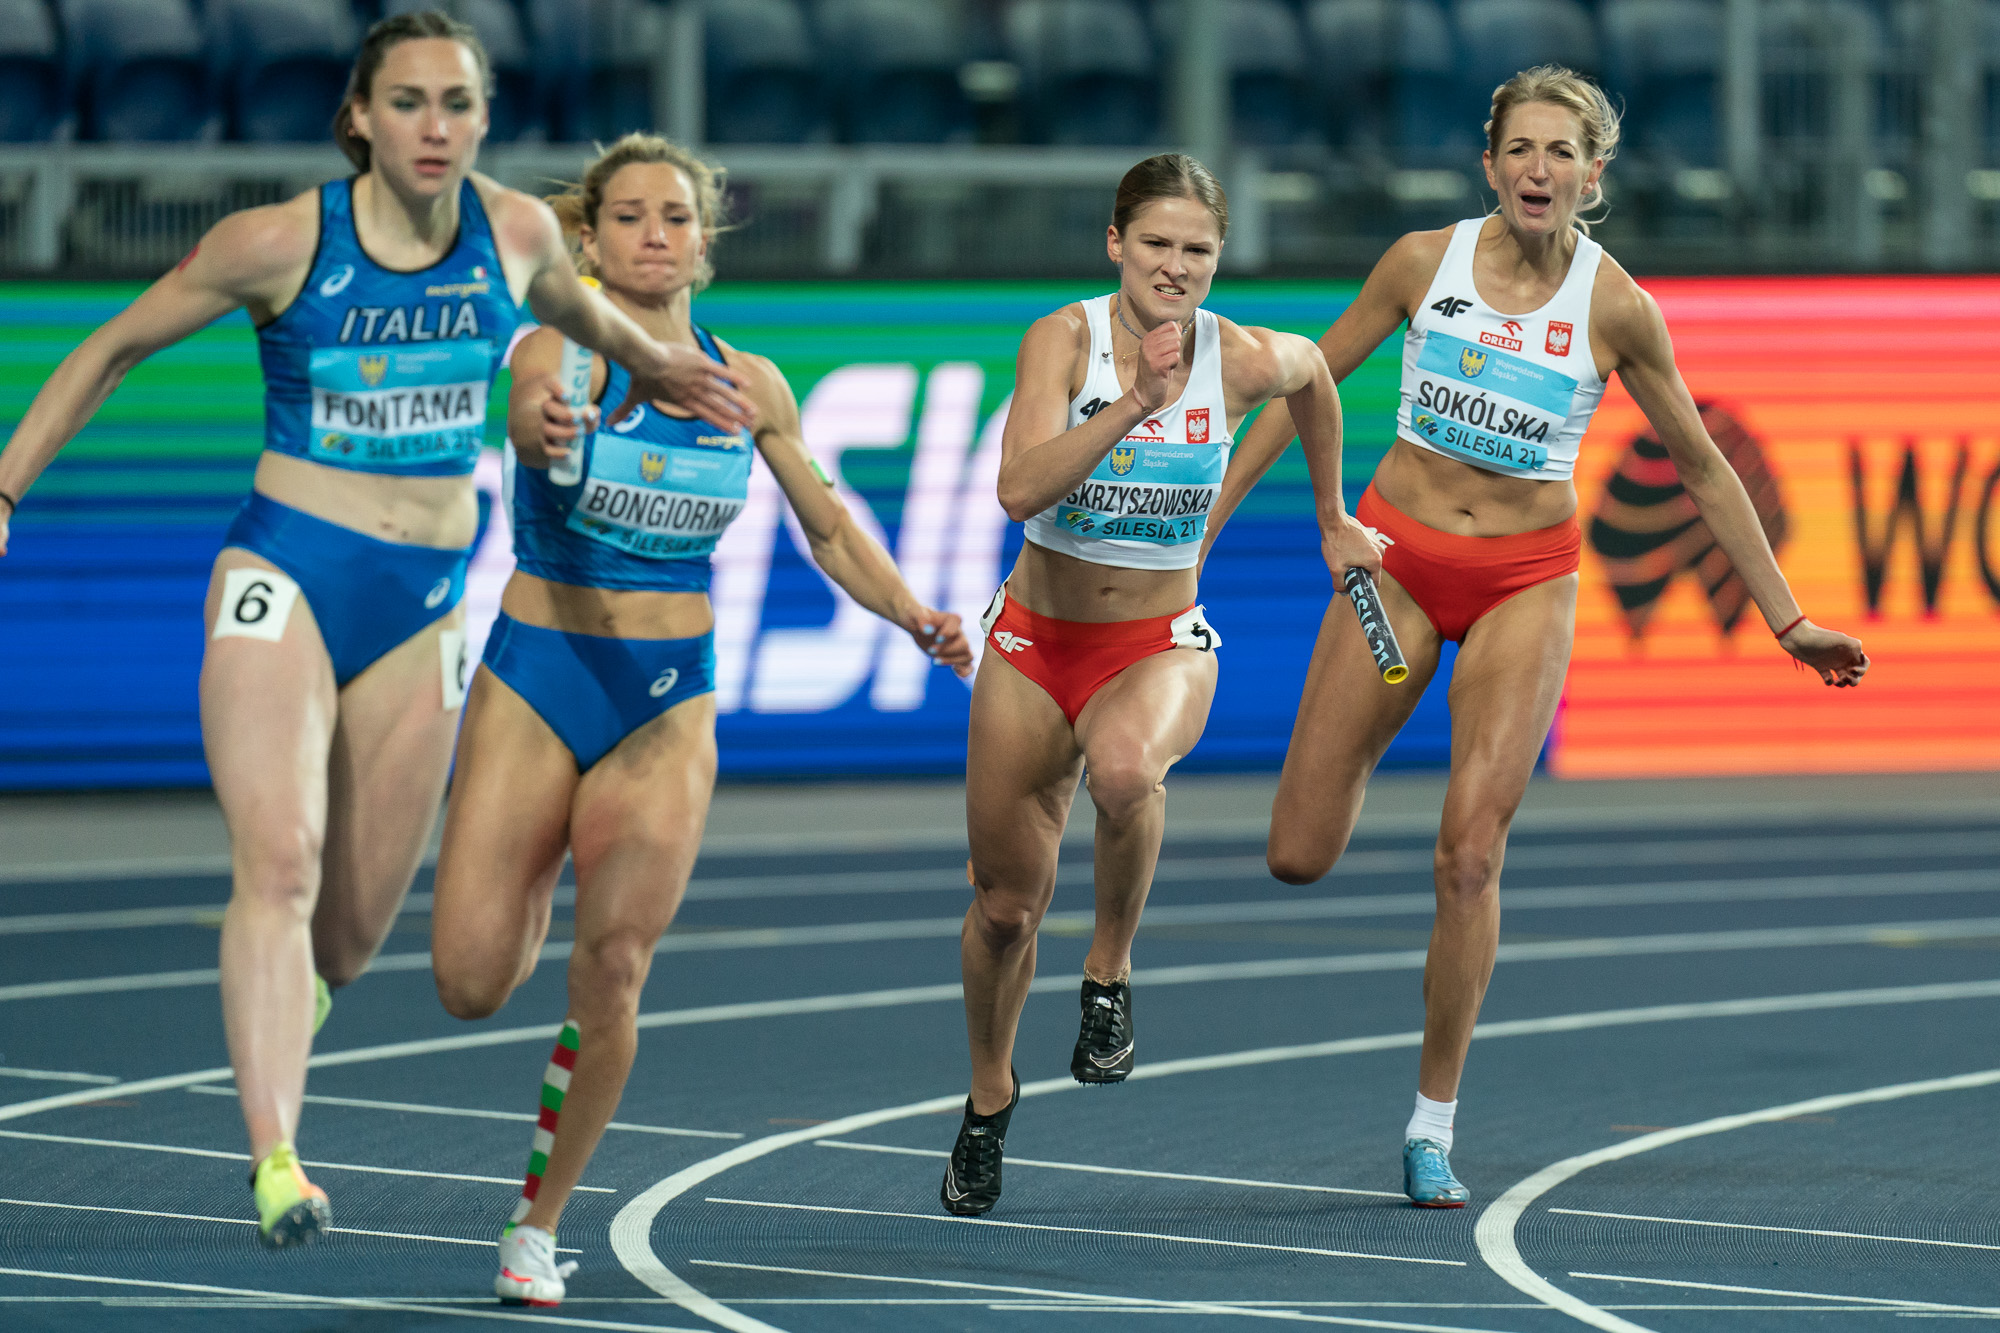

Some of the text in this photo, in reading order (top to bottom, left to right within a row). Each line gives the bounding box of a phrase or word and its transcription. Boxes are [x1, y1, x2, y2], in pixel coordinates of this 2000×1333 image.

[1431, 296, 1474, 318] 4F
[339, 301, 479, 343] ITALIA
[1549, 321, 1572, 330] POLSKA
[1481, 333, 1522, 351] ORLEN
[1495, 358, 1545, 381] Województwo
[324, 387, 474, 431] FONTANA
[1417, 380, 1550, 444] SOKÓLSKA
[366, 436, 448, 460] SILESIA
[1144, 449, 1194, 459] Województwo
[1444, 426, 1537, 466] SILESIA 21
[588, 485, 738, 531] BONGIORN
[1066, 482, 1213, 517] SKRZYSZOWSKA
[1102, 519, 1197, 540] SILESIA 21
[234, 581, 274, 625] 6
